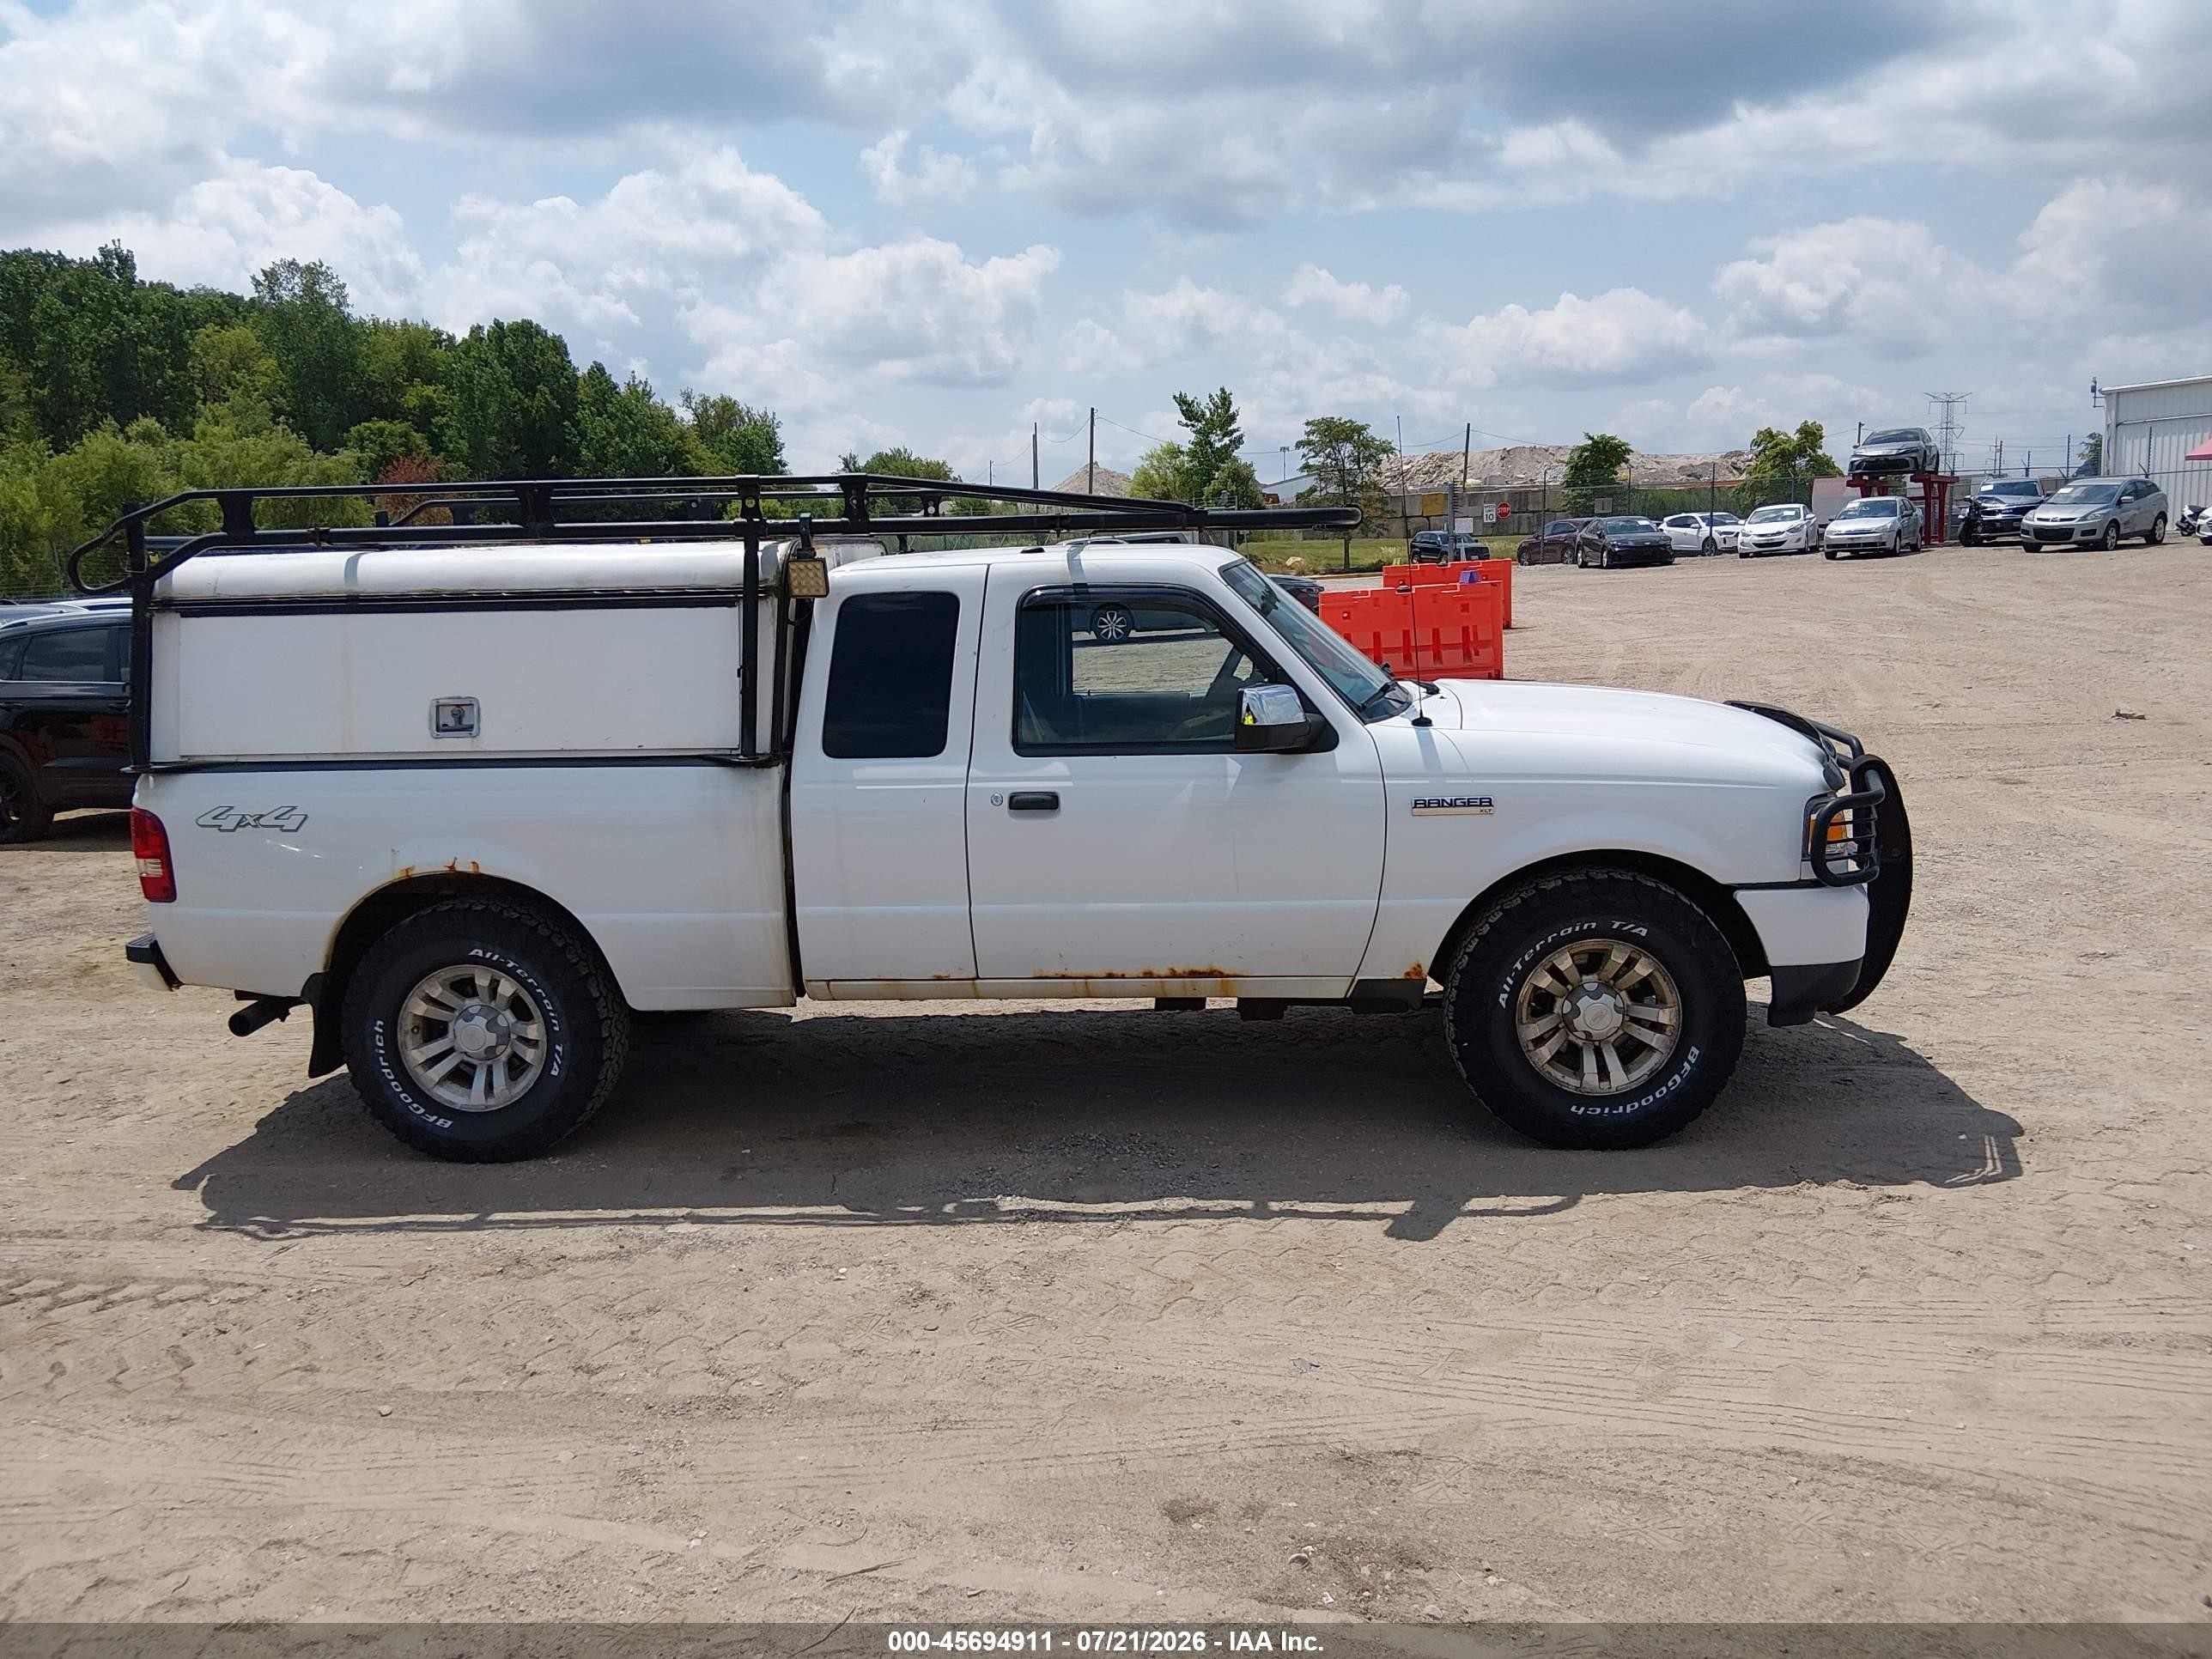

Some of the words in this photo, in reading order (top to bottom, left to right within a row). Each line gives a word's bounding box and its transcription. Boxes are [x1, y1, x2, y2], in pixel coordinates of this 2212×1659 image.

[195, 805, 309, 832] 4x4
[1413, 797, 1494, 808] RANGER
[1498, 921, 1596, 1010] All-Terrain
[1611, 920, 1649, 937] T/A
[468, 948, 562, 1032] All-Terrain
[550, 1043, 564, 1077] T/A
[374, 1019, 453, 1130] BFGoodrich
[1571, 1045, 1699, 1116] BFGoodrich
